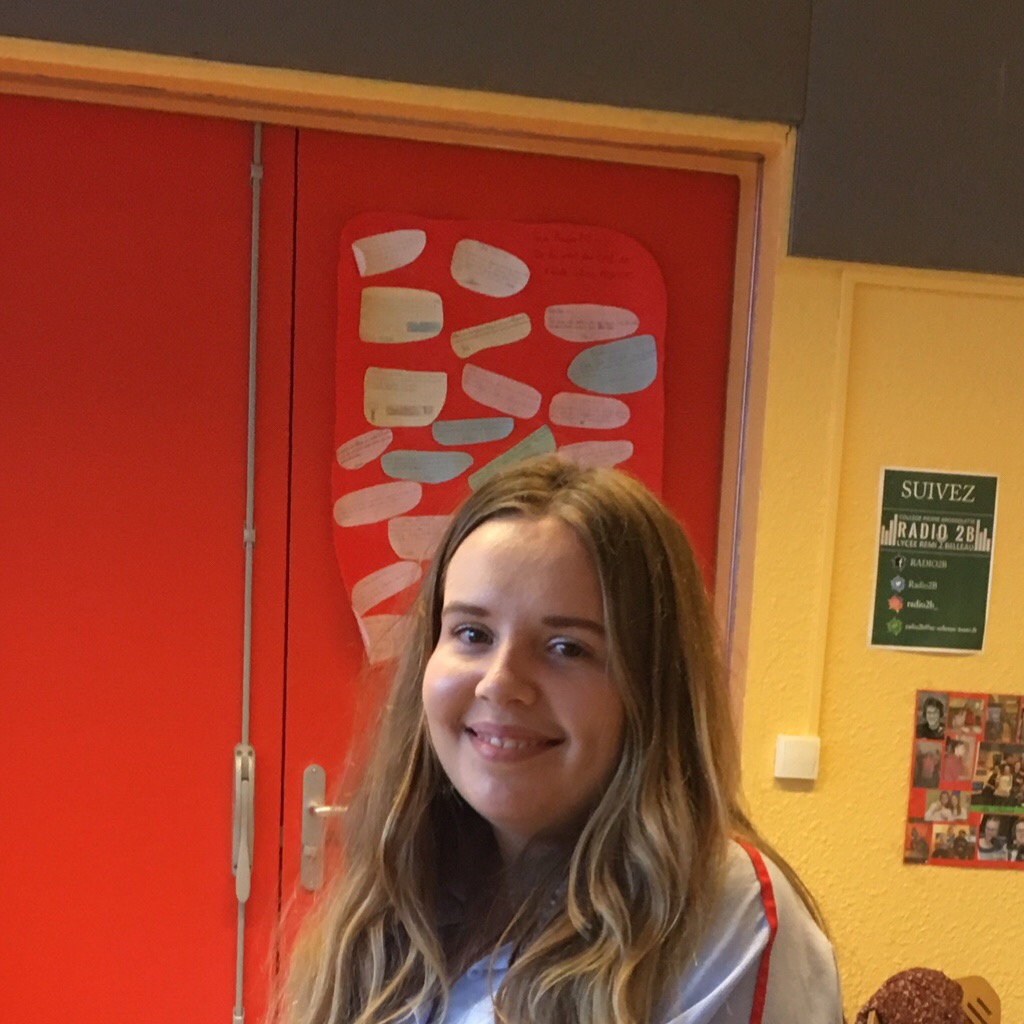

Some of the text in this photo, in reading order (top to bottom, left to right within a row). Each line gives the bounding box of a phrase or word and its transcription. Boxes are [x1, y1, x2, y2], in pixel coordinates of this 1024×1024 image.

[901, 480, 976, 503] SUIVEZ
[897, 521, 975, 542] RADIO 2B
